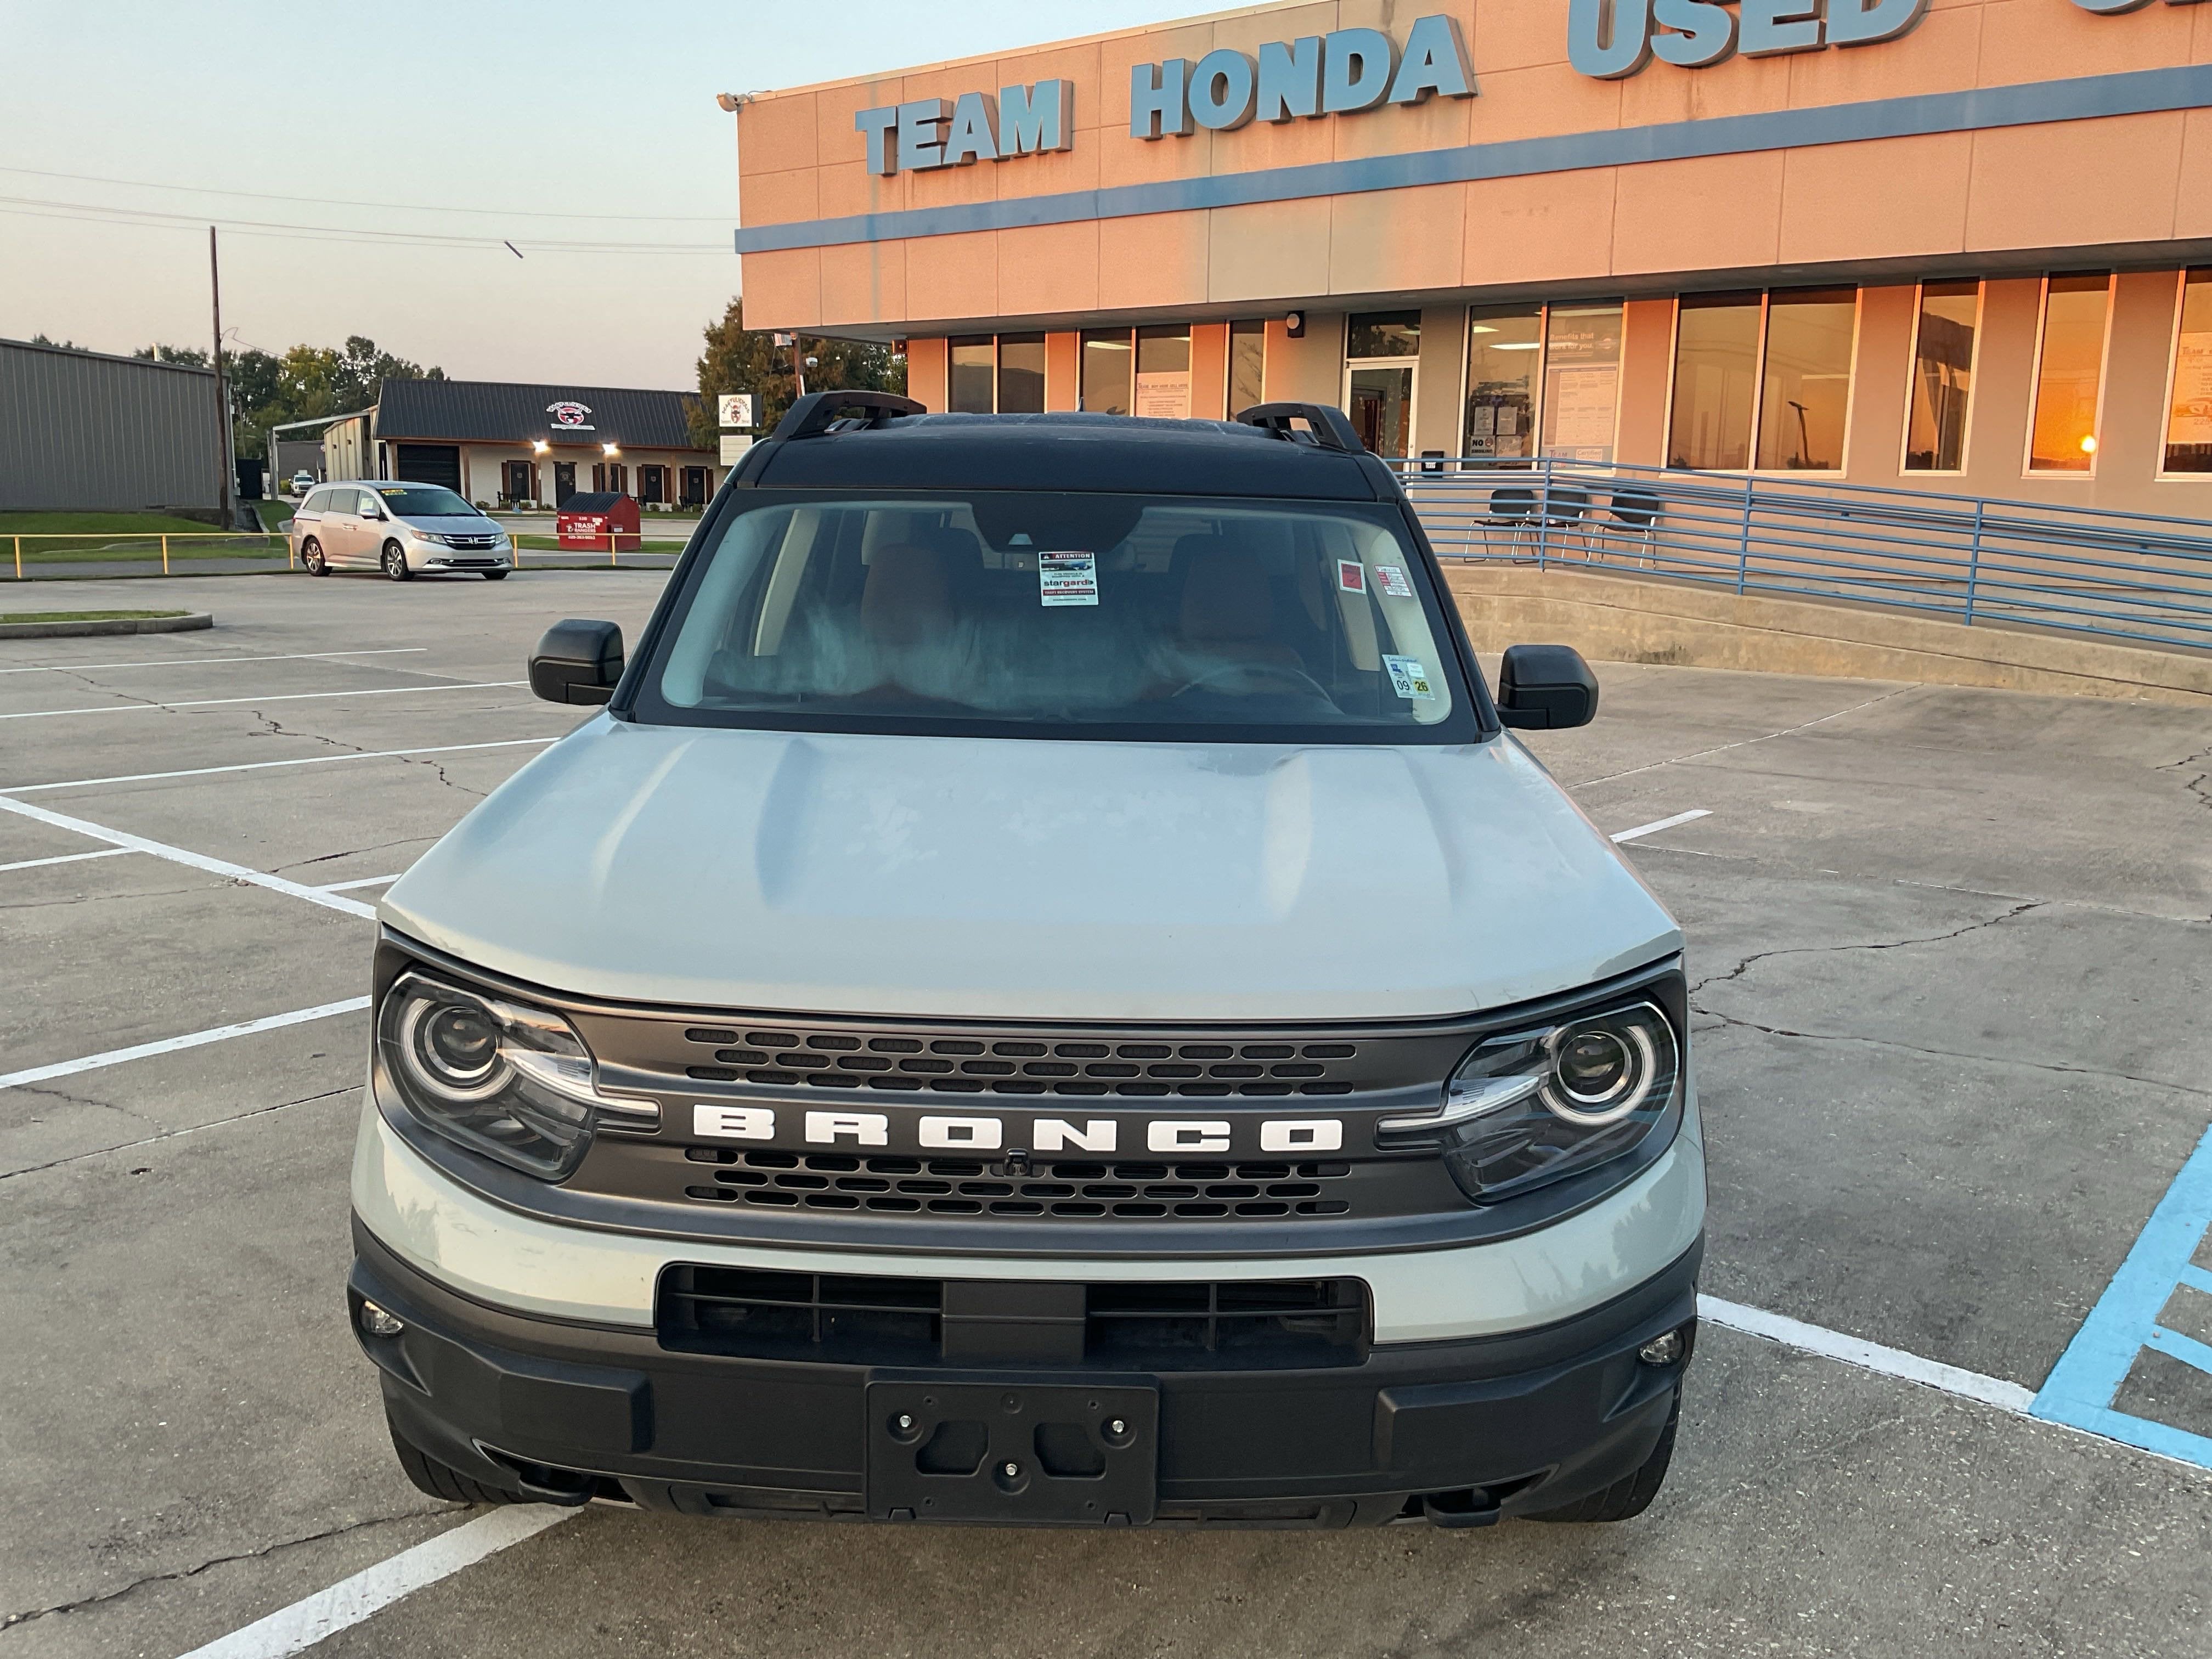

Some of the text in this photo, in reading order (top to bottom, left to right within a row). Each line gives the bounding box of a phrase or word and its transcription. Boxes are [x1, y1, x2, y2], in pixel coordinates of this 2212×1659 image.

[855, 78, 1067, 174] TEAM
[1131, 14, 1476, 139] HONDA
[1549, 449, 1567, 458] TEAM
[1397, 680, 1429, 692] 09 26
[693, 1104, 1342, 1152] BRONCO
